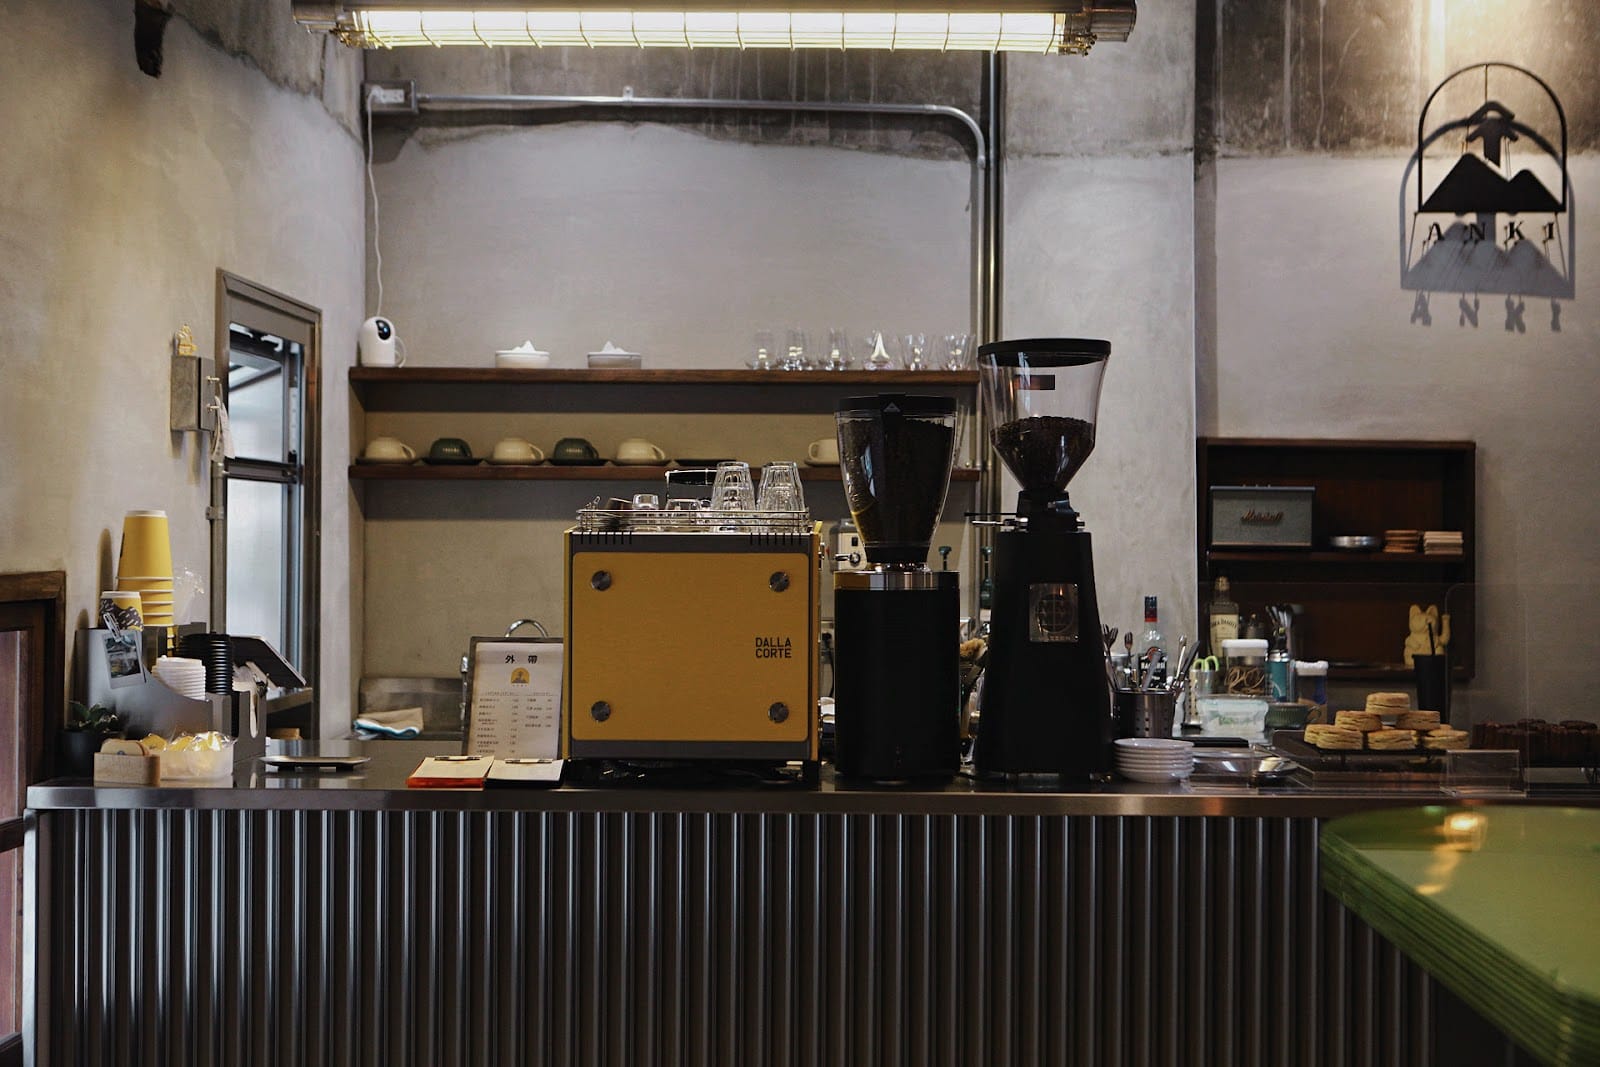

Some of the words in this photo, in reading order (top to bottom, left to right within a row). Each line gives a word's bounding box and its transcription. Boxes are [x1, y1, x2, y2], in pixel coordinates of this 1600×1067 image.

[1427, 221, 1555, 241] ANKI
[755, 637, 792, 648] DALLA
[755, 648, 792, 659] CORTE
